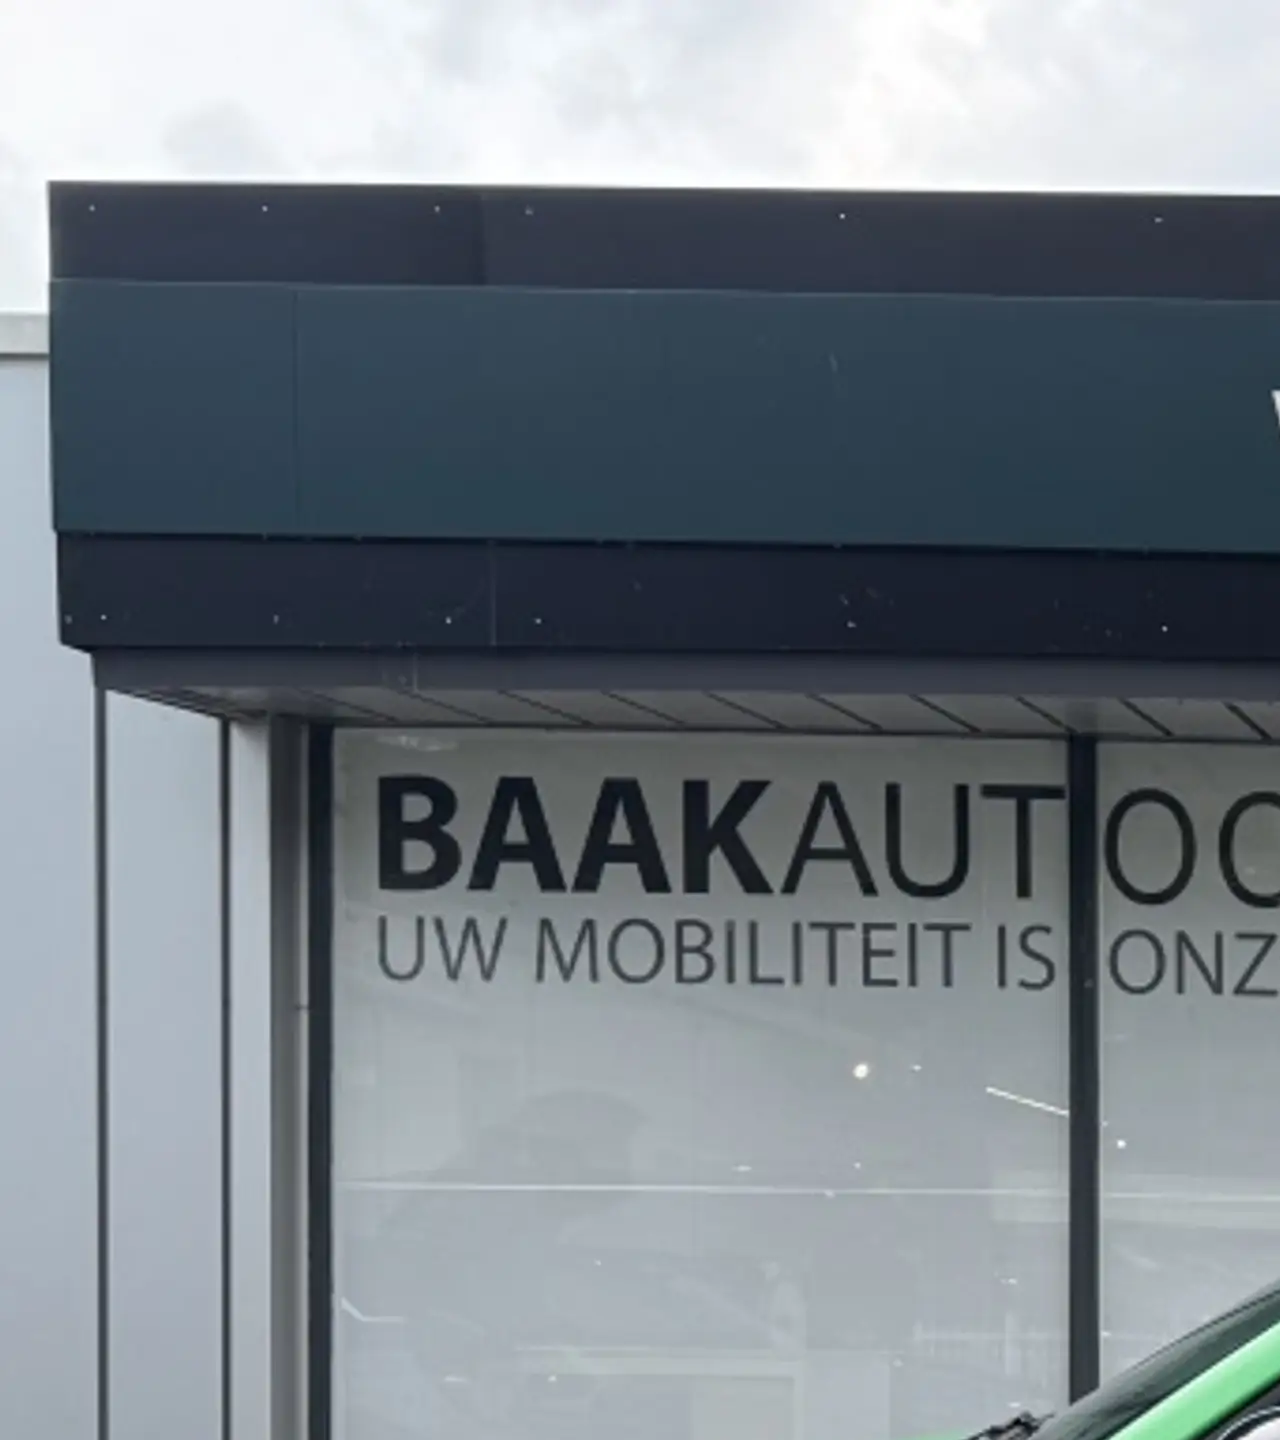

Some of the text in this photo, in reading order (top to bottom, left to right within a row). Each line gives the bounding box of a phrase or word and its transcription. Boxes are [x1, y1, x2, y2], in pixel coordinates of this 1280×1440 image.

[377, 915, 508, 982] UW
[536, 917, 973, 989] MOBILITEIT
[997, 923, 1058, 991] IS
